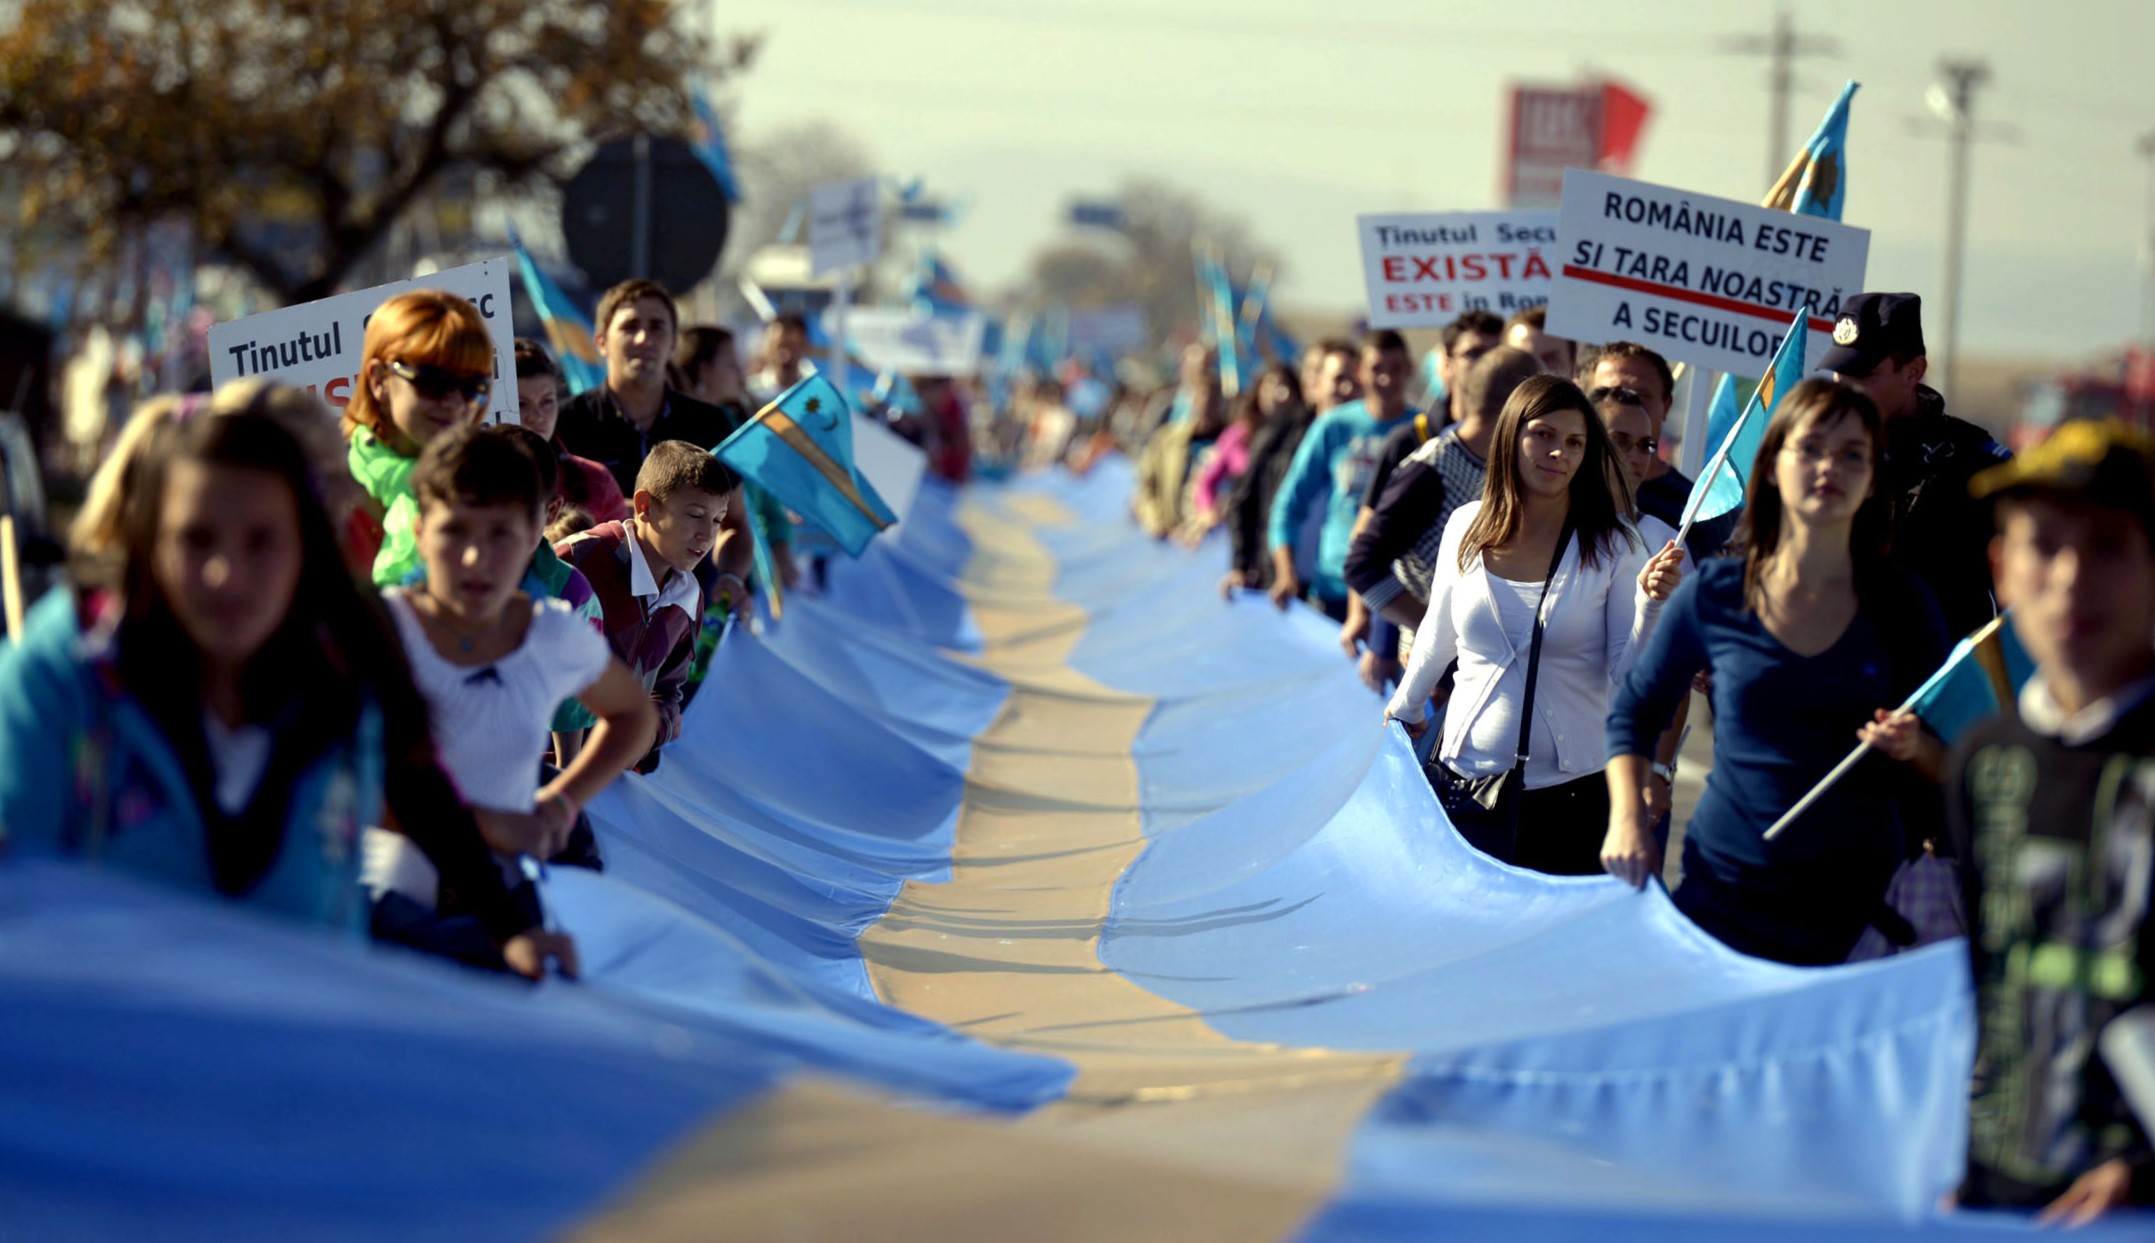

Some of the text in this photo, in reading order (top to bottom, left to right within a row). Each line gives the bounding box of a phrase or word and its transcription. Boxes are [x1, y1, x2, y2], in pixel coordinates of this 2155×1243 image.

[1604, 192, 1829, 263] ROMÂNIA ESTE
[1382, 247, 1552, 283] EXISTĂ
[1385, 293, 1454, 314] ESTE
[1700, 266, 1844, 318] NOASTRĂ
[1613, 302, 1632, 329] A
[229, 321, 342, 377] Tinutul
